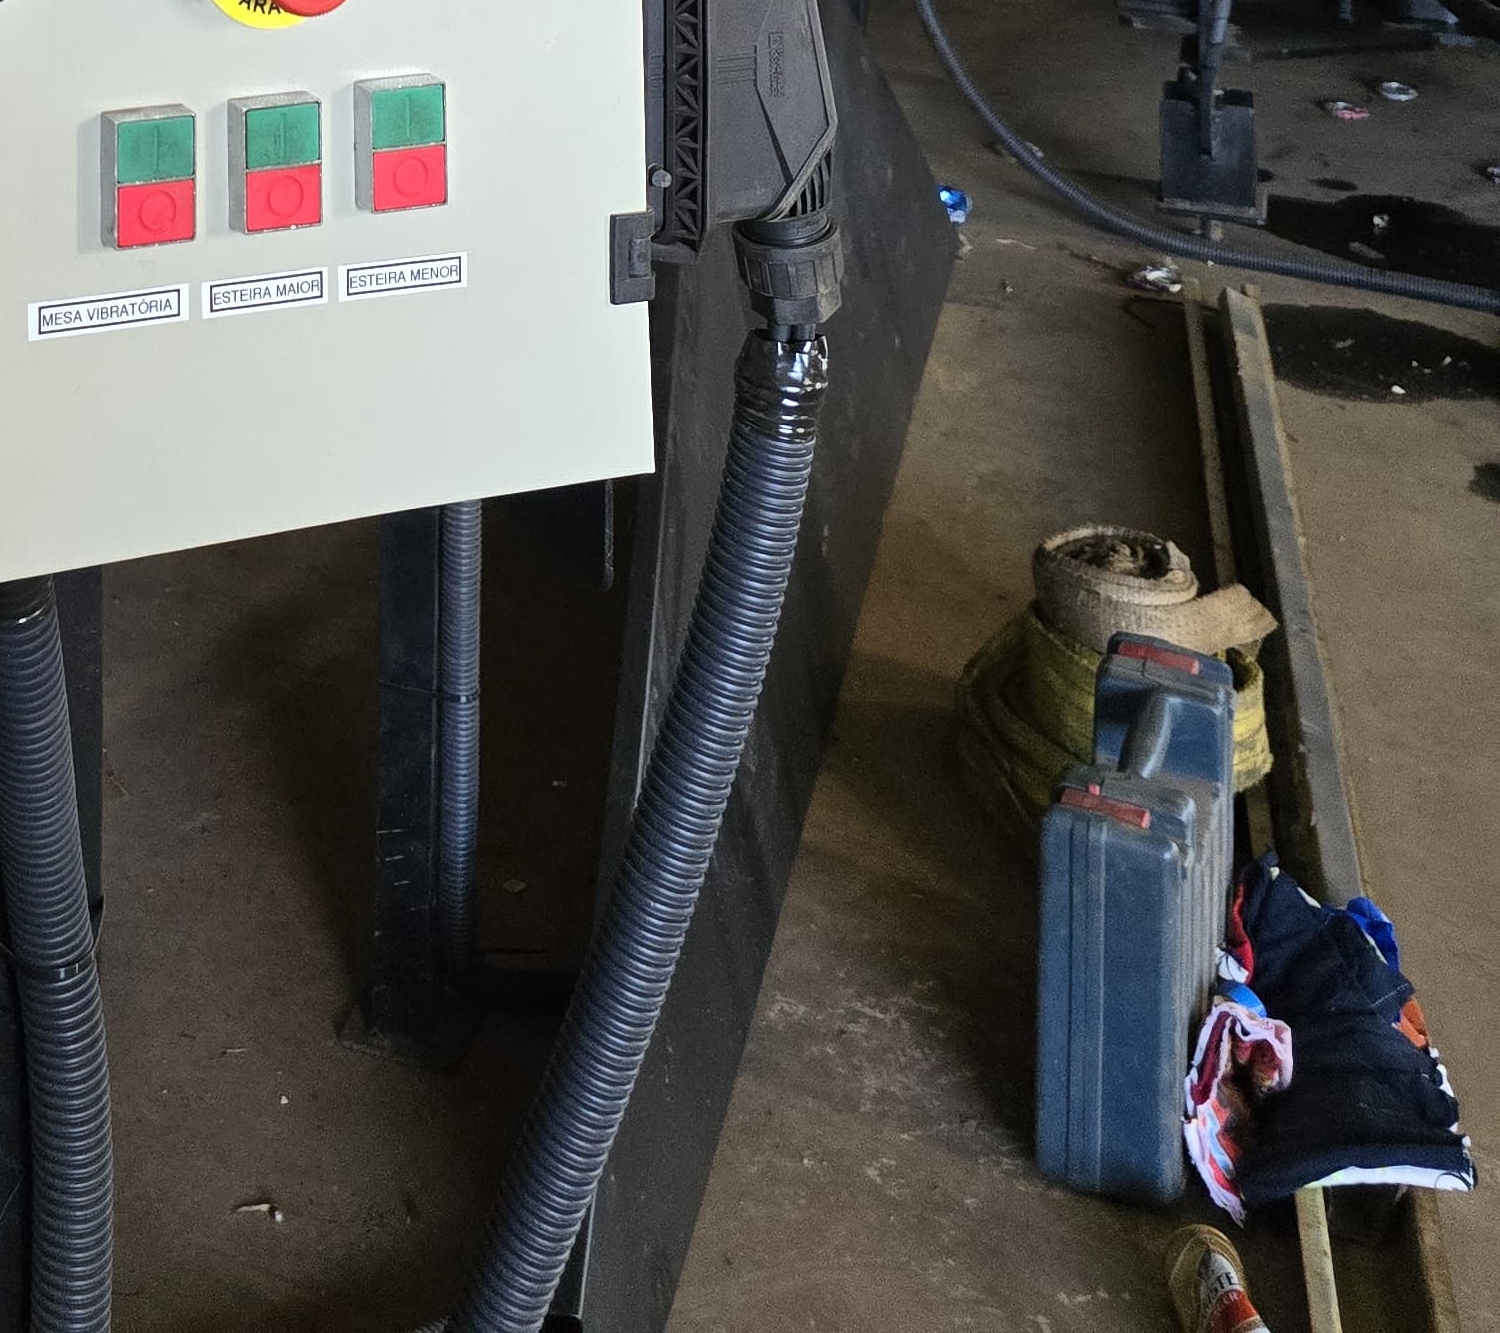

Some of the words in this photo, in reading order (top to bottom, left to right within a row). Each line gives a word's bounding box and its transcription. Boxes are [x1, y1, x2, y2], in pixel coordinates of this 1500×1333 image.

[349, 271, 406, 289] ESTEIRA
[410, 264, 459, 281] MENOR
[213, 286, 272, 306] ESTEIRA
[276, 279, 320, 298] MAIOR
[41, 309, 83, 327] MESA
[86, 297, 173, 322] VIBRATÓRIA
